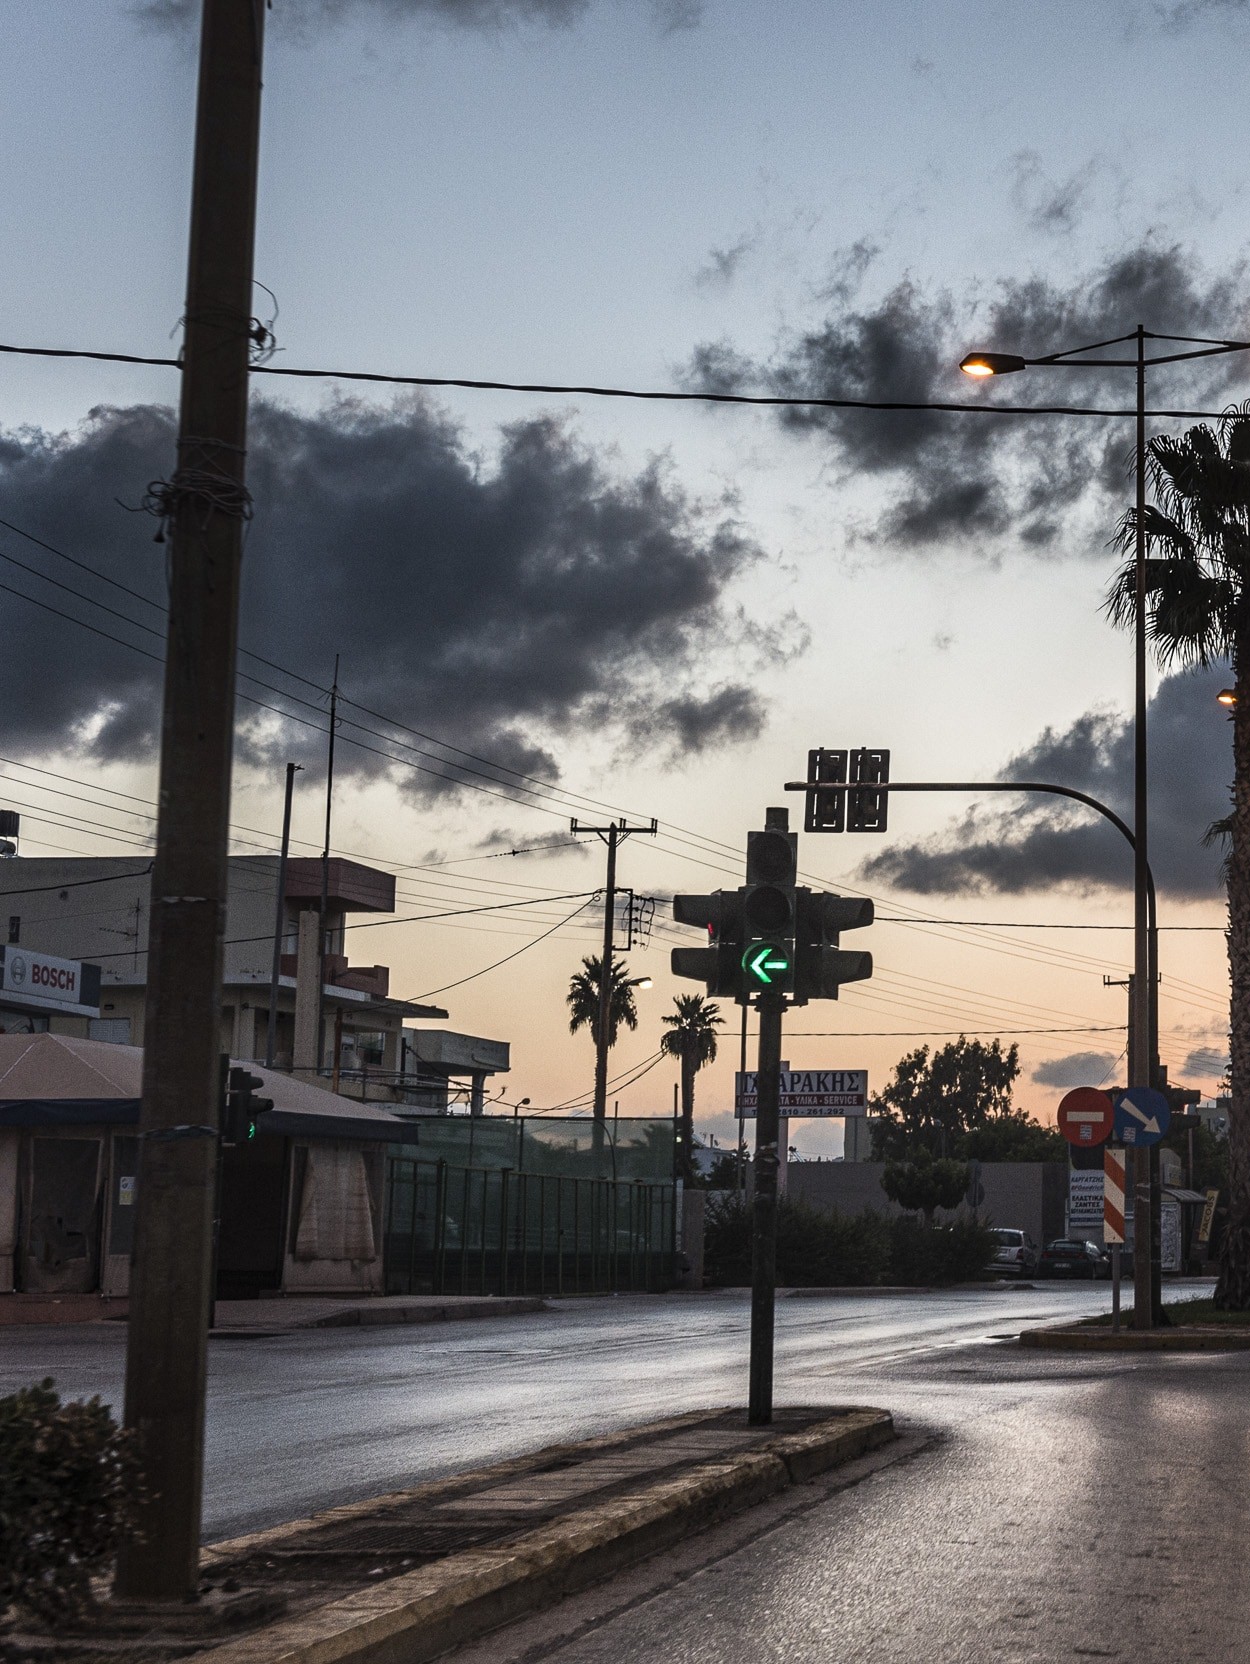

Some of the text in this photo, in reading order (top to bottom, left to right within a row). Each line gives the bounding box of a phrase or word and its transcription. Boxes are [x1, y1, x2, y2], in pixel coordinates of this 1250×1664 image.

[32, 964, 75, 991] BOSCH
[795, 1096, 818, 1105] ΥΛΙΚΑ
[824, 1095, 858, 1105] SERVICE
[1202, 1195, 1215, 1235] JACOBS
